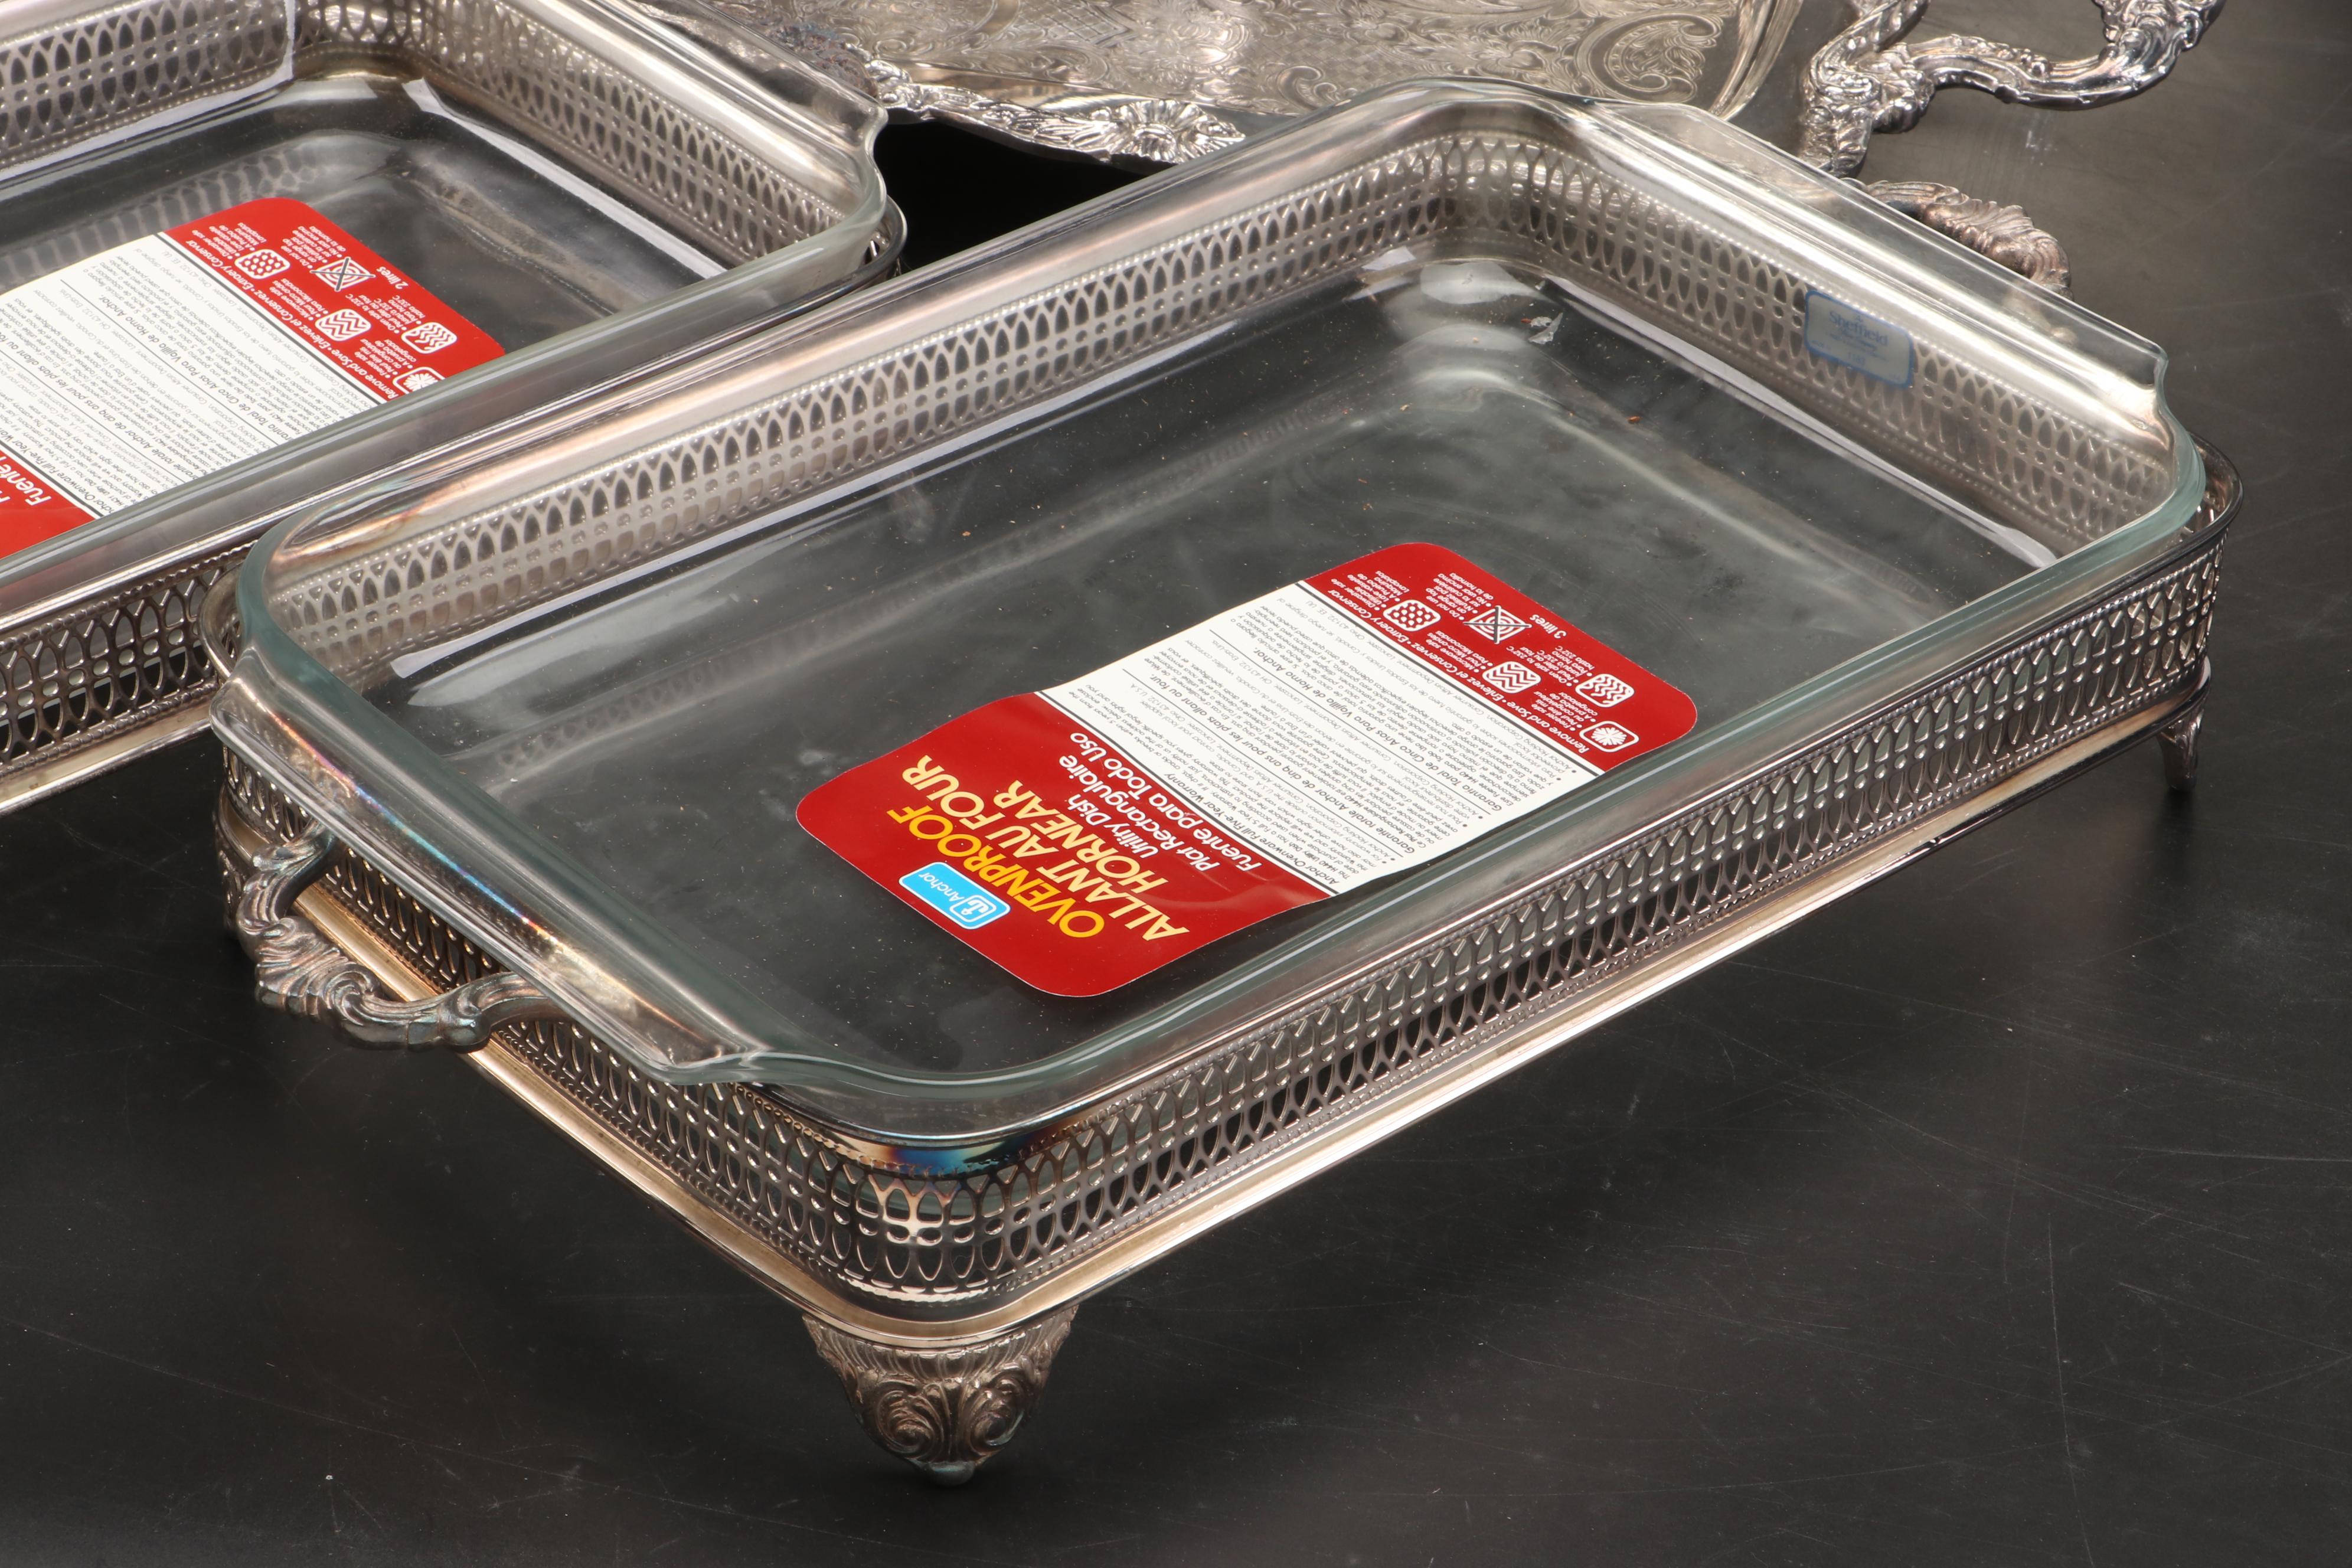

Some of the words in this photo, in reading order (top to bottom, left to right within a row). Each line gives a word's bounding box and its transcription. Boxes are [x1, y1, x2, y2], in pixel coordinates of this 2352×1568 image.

[186, 240, 223, 267] Conservar
[226, 269, 254, 290] Extraer
[377, 267, 401, 285] litres
[99, 295, 127, 316] Anchor.
[254, 290, 293, 321] Conservez
[125, 316, 149, 335] Horno
[1828, 310, 1888, 345] Sheffield
[148, 335, 159, 343] de
[299, 325, 331, 349] Enlevez
[17, 350, 39, 365] allant
[159, 343, 181, 362] Vajilla
[331, 349, 353, 365] Save
[38, 365, 59, 378] plats
[181, 361, 201, 376] Para
[346, 363, 367, 375] and
[55, 380, 68, 388] les
[198, 375, 220, 389] Años
[365, 375, 398, 399] Remove
[66, 388, 88, 400] pour
[218, 389, 239, 404] Cinco
[84, 400, 99, 410] ans
[99, 409, 116, 422] cinq
[247, 411, 269, 426] Total
[125, 430, 153, 449] Anchor
[12, 440, 47, 465] Five-Year
[152, 449, 175, 464] totale
[41, 463, 59, 473] Full
[0, 464, 51, 505] Fuente
[57, 473, 96, 501] Ovenware
[1331, 579, 1346, 588] safe
[1367, 580, 1390, 595] Prueba
[1438, 573, 1463, 589] encima
[1426, 588, 1438, 596] top
[1434, 586, 1449, 594] pas
[1462, 589, 1477, 597] usar
[1328, 590, 1372, 618] Conservar
[1426, 596, 1439, 604] use
[1438, 595, 1458, 608] range
[1376, 621, 1409, 643] Extraer
[1530, 615, 1558, 633] litres
[1436, 631, 1474, 655] Microondas
[1554, 631, 1566, 639] 3
[1426, 639, 1441, 648] safe
[1427, 633, 1467, 658] Micro-ondes
[1520, 647, 1534, 656] four
[1253, 648, 1286, 671] Anchor.
[1411, 642, 1458, 672] Conservez
[1440, 648, 1475, 670] Microwave
[1466, 656, 1482, 667] Pour
[1472, 653, 1488, 664] Para
[1552, 651, 1572, 664] horno
[1575, 657, 1595, 670] hasta
[1534, 662, 1550, 672] safe
[1543, 661, 1559, 671] aller
[1572, 662, 1588, 674] Para
[1150, 674, 1170, 690] four.
[1285, 671, 1313, 690] Horno
[1549, 671, 1567, 683] Oven
[1557, 670, 1574, 680] Peut
[1169, 689, 1182, 697] au
[1313, 690, 1326, 698] de
[1466, 677, 1504, 701] Enlevez
[1181, 698, 1207, 716] allant
[1326, 698, 1353, 717] Vajilla
[1507, 702, 1531, 717] Save
[1531, 704, 1547, 713] safe
[1536, 699, 1549, 707] mis
[1559, 692, 1598, 716] congelador
[1560, 700, 1586, 716] prueba
[1207, 717, 1232, 731] plats
[1354, 716, 1376, 731] Para
[1527, 715, 1550, 727] and
[1546, 713, 1571, 729] Freezer
[1560, 715, 1577, 726] Peut
[1229, 731, 1243, 741] les
[1376, 730, 1400, 746] Años
[1549, 727, 1589, 753] Remove
[1070, 733, 1106, 761] Uso
[1242, 741, 1268, 755] pour
[1400, 746, 1425, 762] Cinco
[1265, 755, 1282, 766] ans
[1425, 762, 1439, 770] de
[1104, 759, 1152, 800] Todo
[1282, 765, 1302, 779] cinq
[1436, 770, 1462, 786] Total
[902, 755, 1005, 830] FOUR
[1164, 774, 1204, 803] Warranty
[1302, 780, 1315, 789] de
[1059, 755, 1184, 850] Rectangulaire
[1315, 789, 1349, 810] Anchor
[1067, 794, 1112, 825] Dish
[1149, 793, 1204, 829] para
[1203, 802, 1245, 830] Five-Year
[1348, 810, 1376, 828] totale
[994, 780, 1168, 894] HORNEAR
[1103, 823, 1158, 858] Utility
[1241, 828, 1260, 839] Full
[1376, 827, 1415, 854] Garantie
[985, 826, 1059, 858] AU
[1193, 828, 1262, 871] Fuente
[1289, 842, 1303, 851] Dish
[1176, 847, 1220, 871] Plat
[1259, 838, 1306, 867] Ovenware
[1304, 851, 1319, 861] Utility
[887, 805, 1105, 937] OVENPROOF
[1305, 865, 1339, 884] Anchor
[919, 873, 965, 901] Anchor
[1036, 859, 1190, 941] ALLANT
